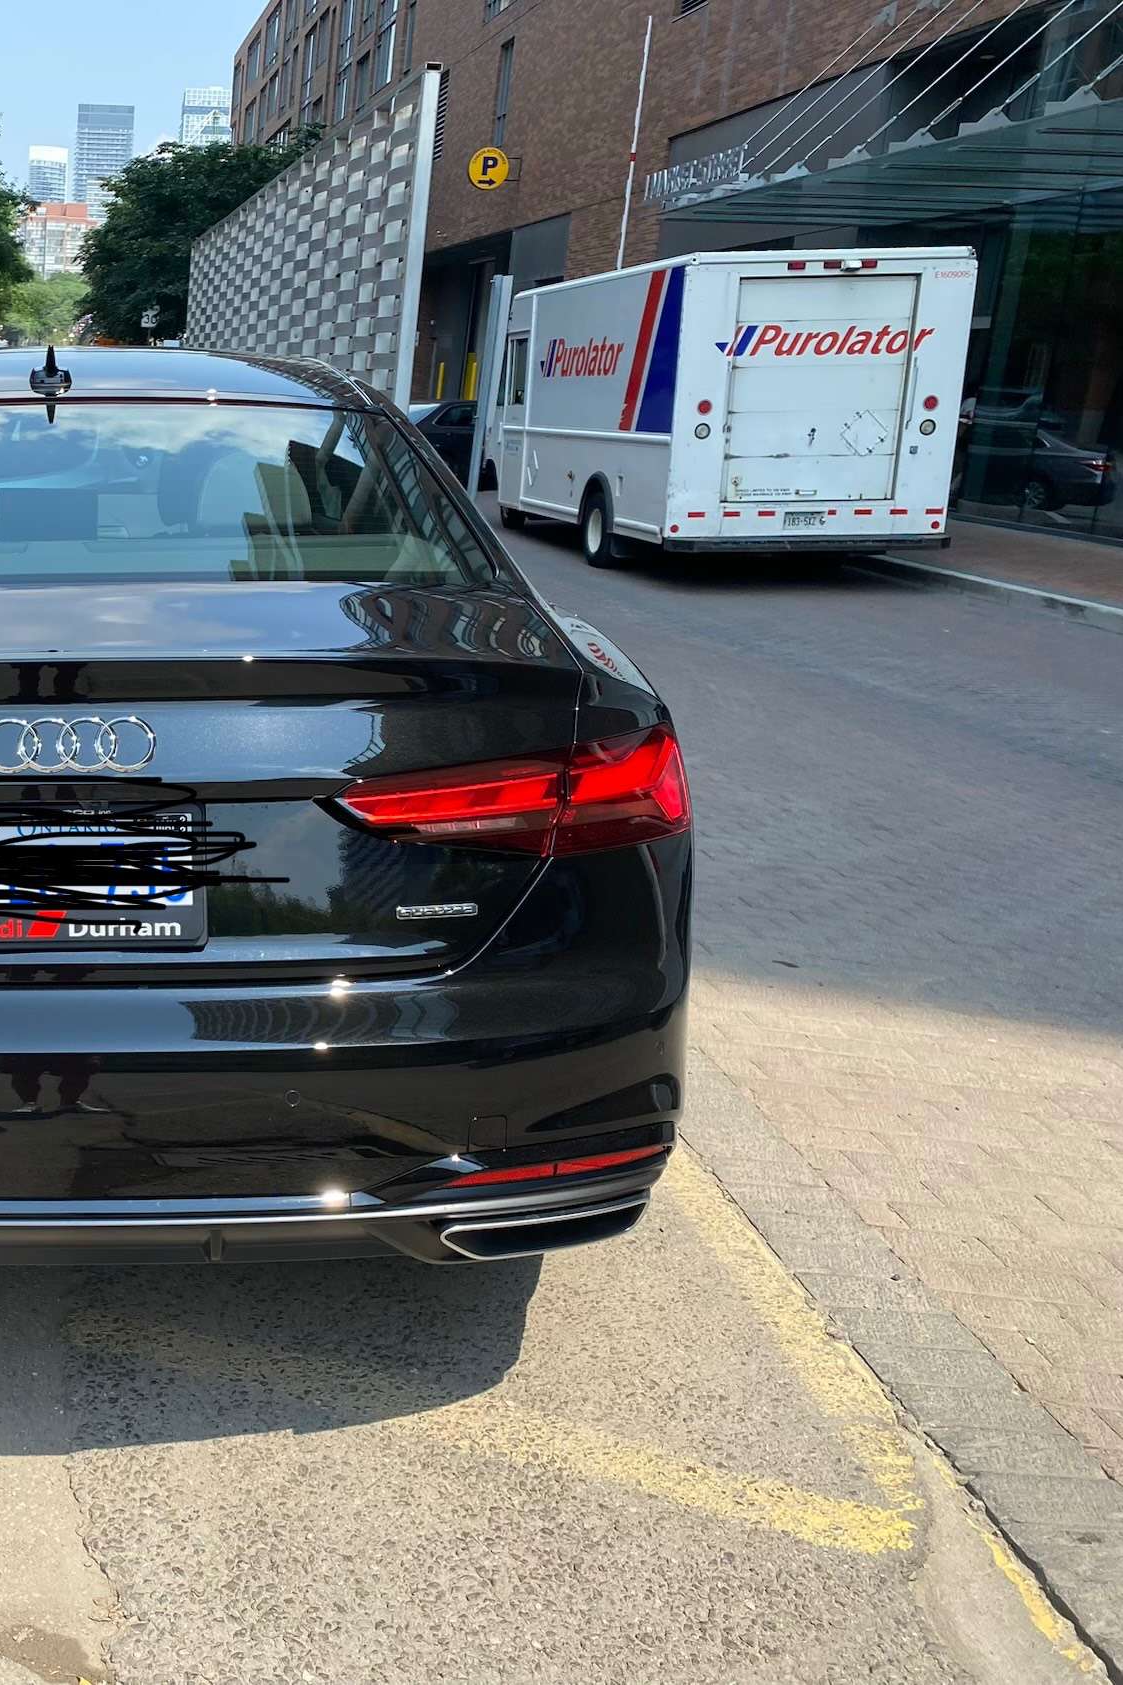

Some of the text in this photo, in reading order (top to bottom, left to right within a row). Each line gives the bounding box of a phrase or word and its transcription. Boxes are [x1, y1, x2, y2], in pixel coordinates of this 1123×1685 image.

[482, 156, 498, 176] P
[749, 323, 935, 357] Purolator
[553, 336, 625, 378] Purolator
[68, 918, 181, 938] Durham
